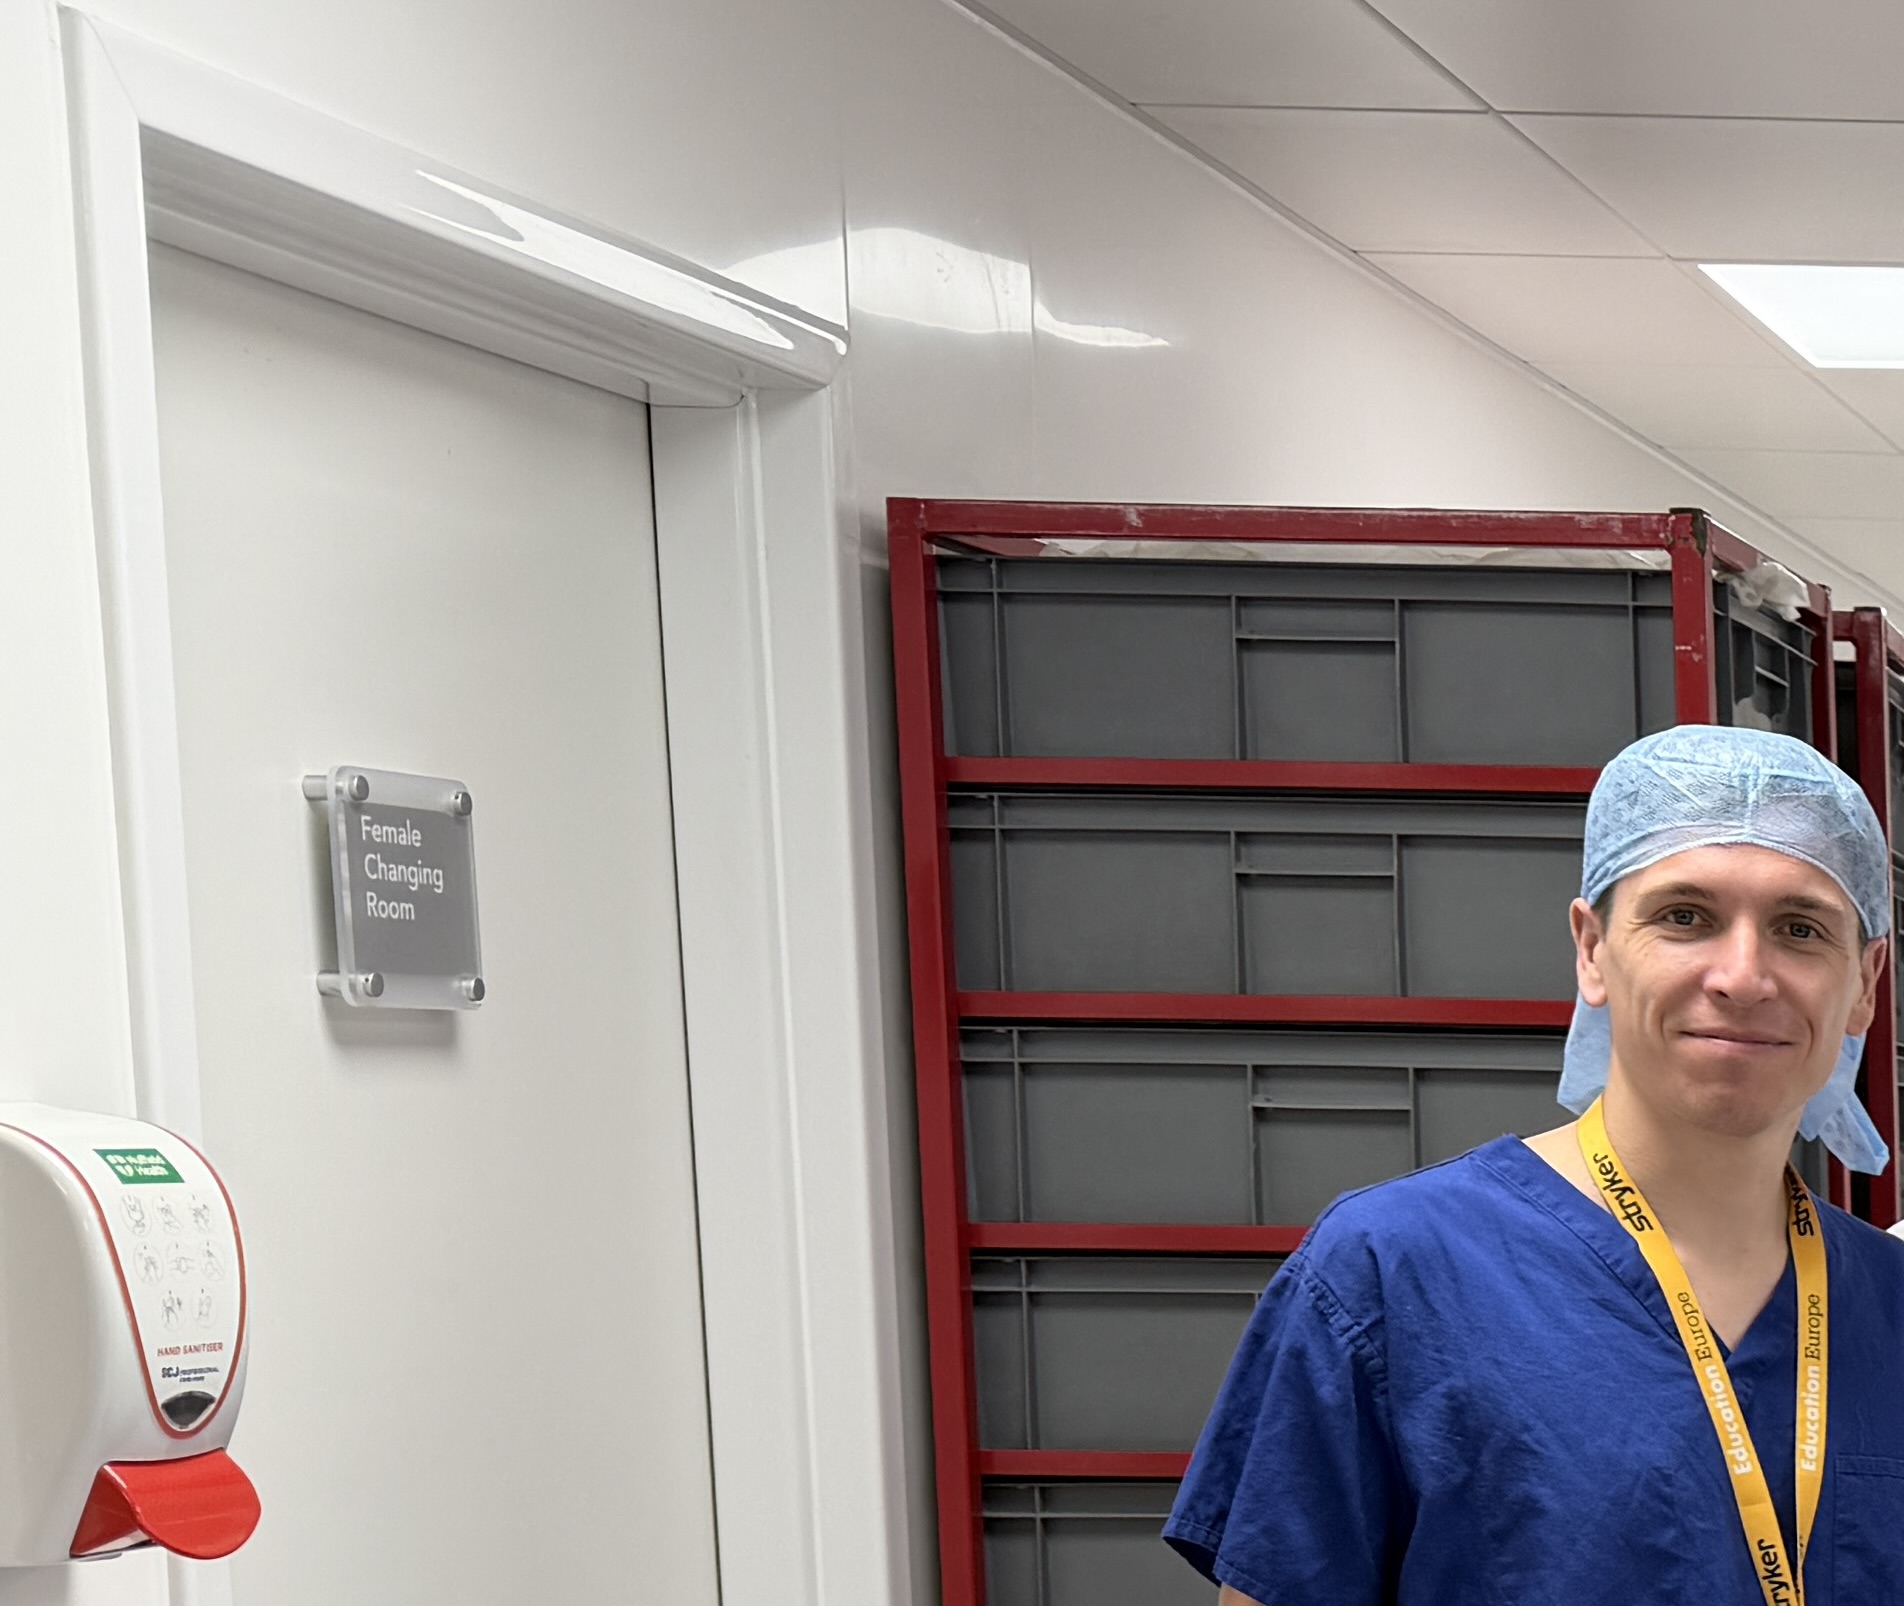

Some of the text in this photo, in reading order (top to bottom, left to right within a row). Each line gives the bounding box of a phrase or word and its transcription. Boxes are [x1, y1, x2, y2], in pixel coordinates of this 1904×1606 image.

[360, 815, 422, 847] Female
[364, 853, 444, 894] Changing
[366, 891, 415, 920] Room
[1593, 1152, 1654, 1232] stryker
[157, 1345, 180, 1357] HAND
[1677, 1291, 1753, 1475] Education Europe
[1800, 1293, 1824, 1472] Education Europe
